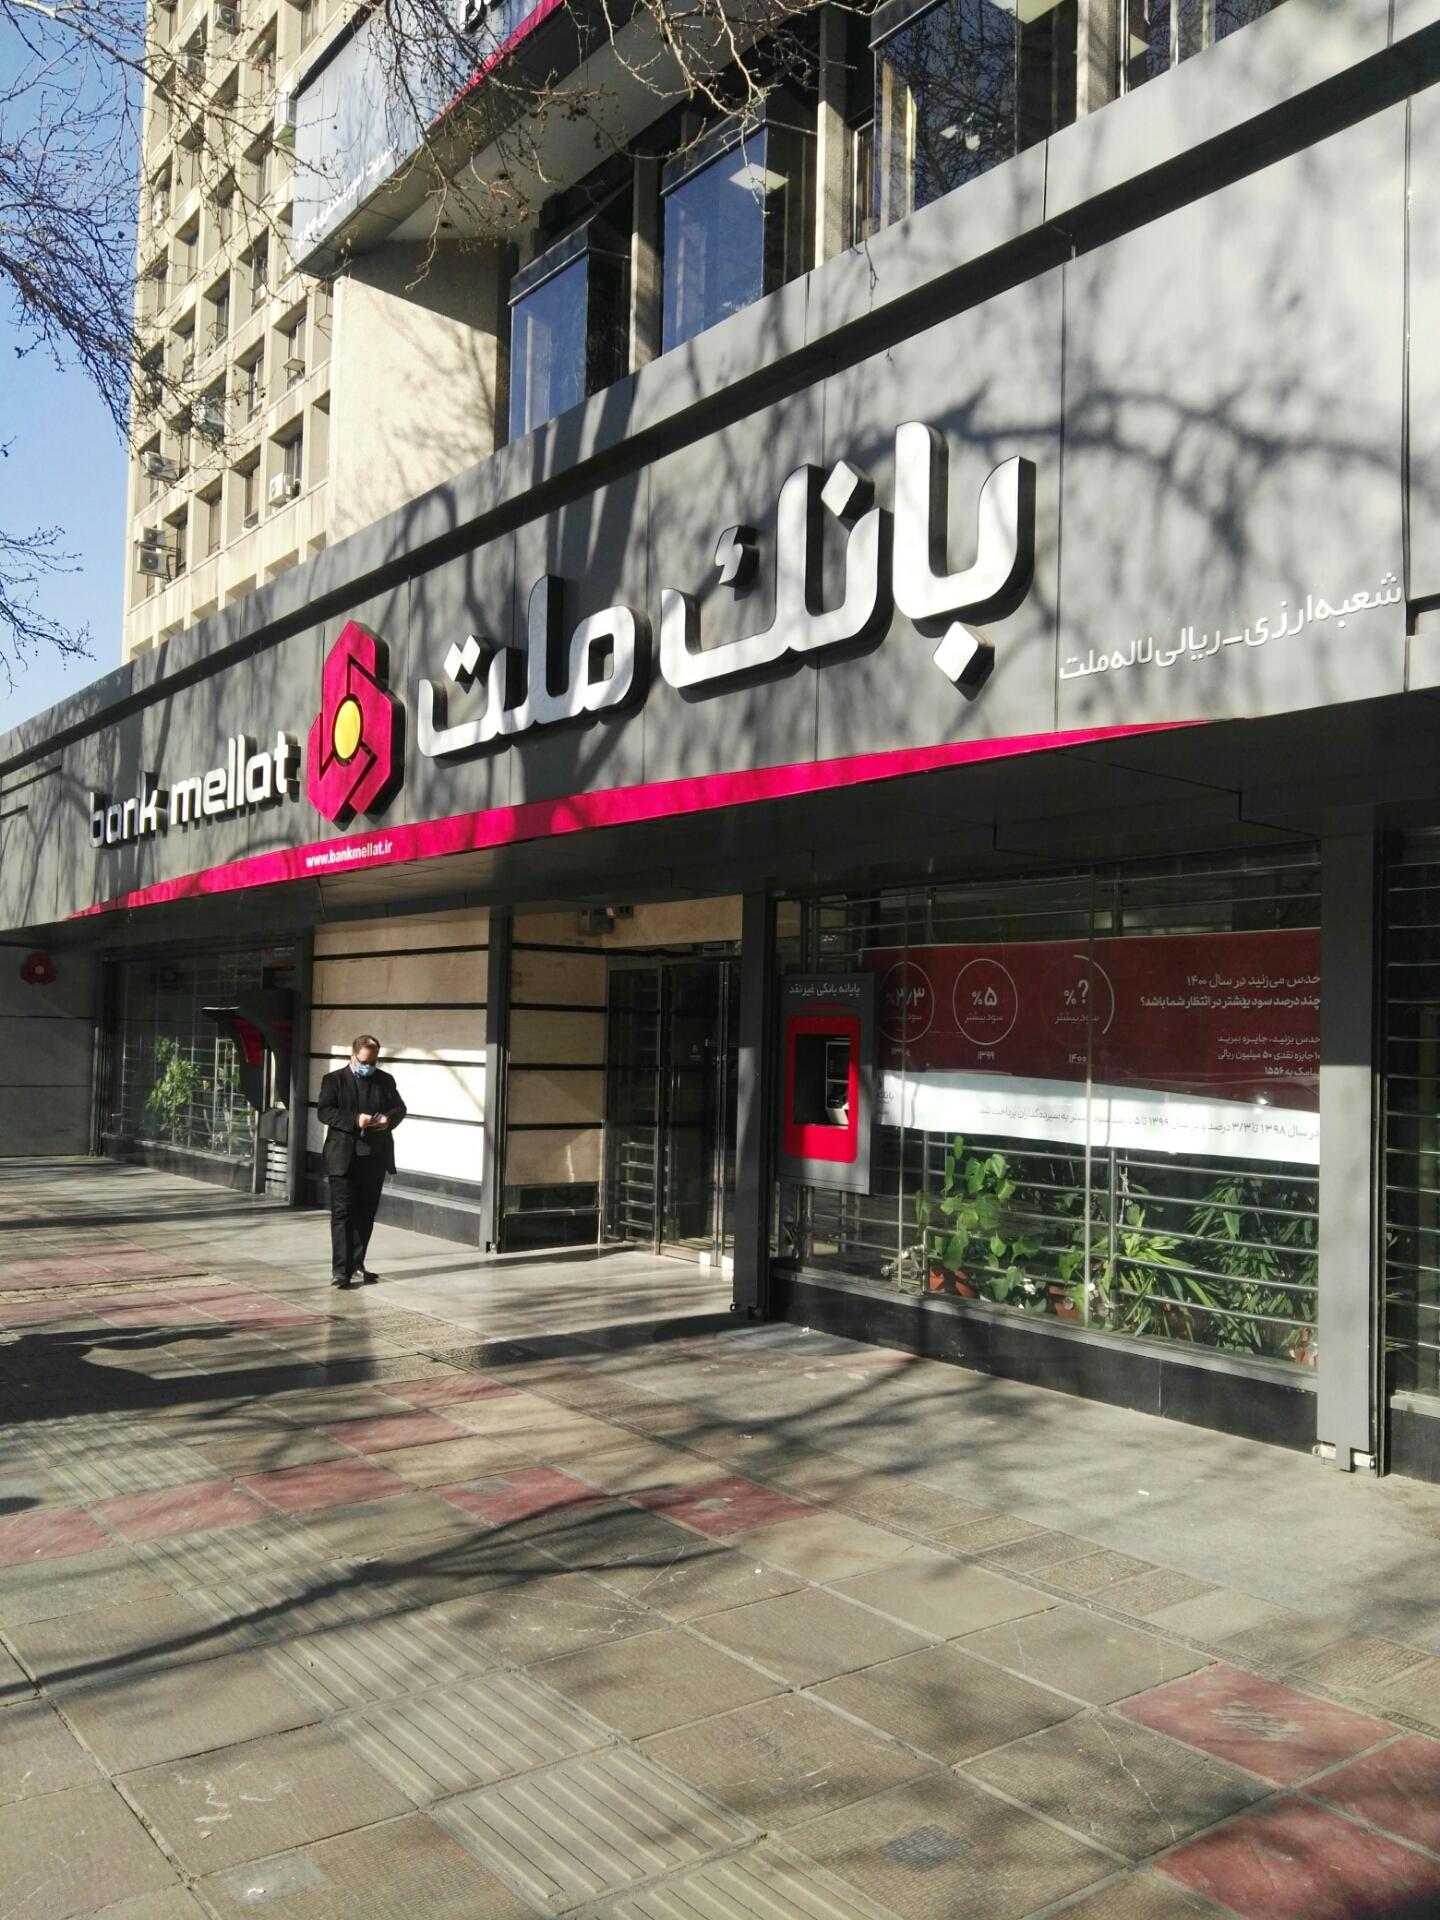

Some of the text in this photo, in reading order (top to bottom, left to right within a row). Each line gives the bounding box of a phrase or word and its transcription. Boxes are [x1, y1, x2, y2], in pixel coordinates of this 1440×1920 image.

[1315, 571, 1402, 628] شعبه
[418, 575, 652, 758] ملت
[1059, 649, 1109, 681] ملت
[89, 731, 300, 847] bank mellat
[305, 841, 393, 868] www.bankmellat.ir
[1186, 975, 1207, 987] ۱۴۰۰
[1208, 973, 1233, 989] سال
[1234, 977, 1247, 988] در
[1287, 975, 1321, 988] حدس
[816, 982, 838, 996] بانکی
[838, 983, 861, 997] پایانه
[1185, 994, 1211, 1009] انتظار
[1210, 996, 1223, 1009] در
[1252, 997, 1272, 1009] سود
[1272, 995, 1299, 1009] درصد
[1299, 996, 1321, 1010] چند
[1295, 1035, 1321, 1046] حدس
[1273, 1050, 1294, 1061] نقدی
[1294, 1050, 1314, 1062] جایزه
[1264, 1066, 1284, 1076] ۱۵۵۶
[1149, 1116, 1169, 1128] ۱۳۹۹
[1261, 1123, 1286, 1135] ۱۳۹۸
[1287, 1122, 1308, 1138] سال
